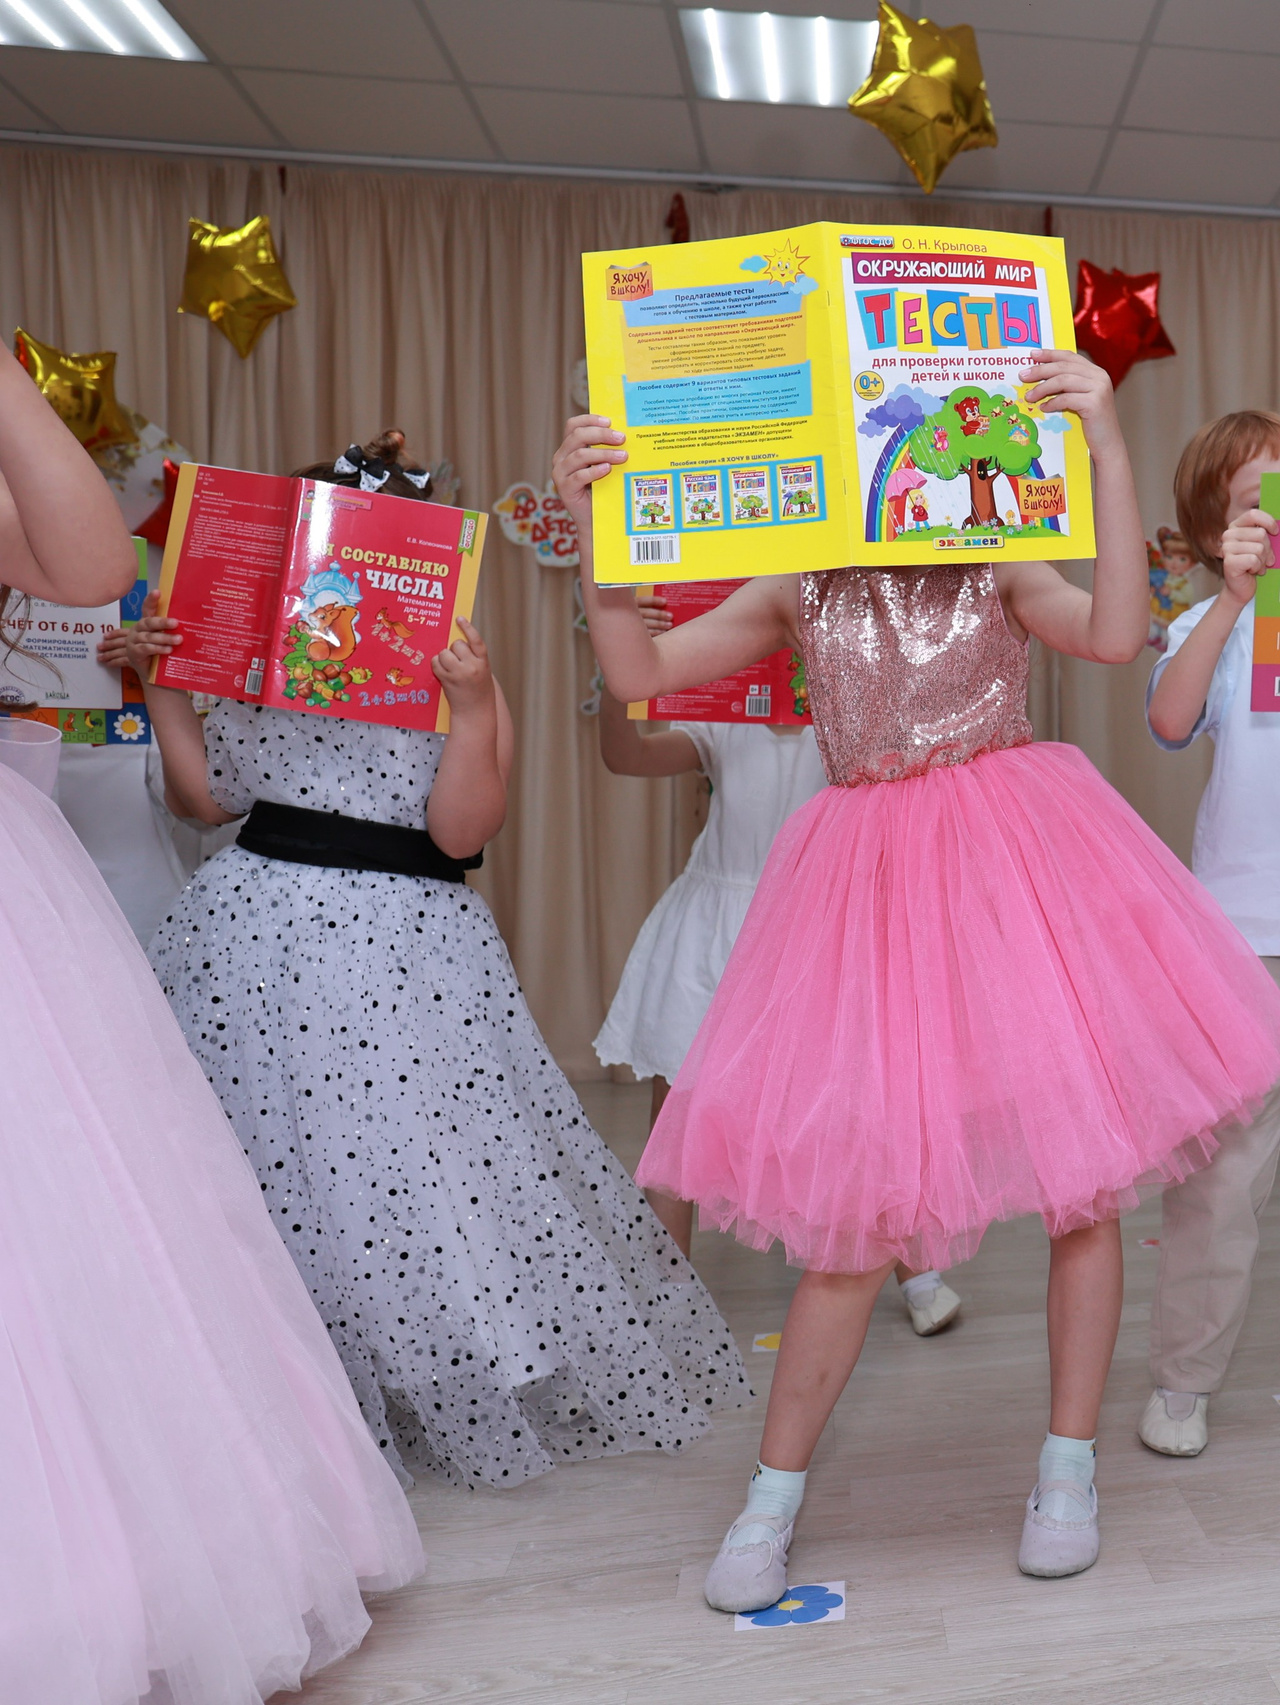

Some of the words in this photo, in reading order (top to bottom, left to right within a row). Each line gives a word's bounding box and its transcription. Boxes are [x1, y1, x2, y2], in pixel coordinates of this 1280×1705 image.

[902, 238, 914, 249] О.
[918, 238, 930, 250] Н.
[934, 239, 987, 254] Крылова
[995, 265, 1032, 282] МИР
[675, 289, 732, 302] Предлагаемые
[733, 287, 754, 296] тесты
[864, 293, 1040, 349] ТЕСТЫ
[872, 357, 896, 369] для
[900, 356, 964, 368] проверки
[859, 375, 880, 389] 0+
[912, 370, 949, 383] детей
[954, 372, 960, 381] к
[963, 371, 1005, 381] школе
[670, 459, 696, 467] Пособия
[698, 457, 716, 465] серии
[726, 454, 743, 462] ХОЧУ
[751, 451, 778, 460] ШКОЛУ»
[531, 515, 576, 542] ДЕТС
[418, 539, 453, 550] Колесникова
[553, 537, 578, 556] СА
[341, 546, 449, 577] СОСТАВЛЯЮ
[365, 569, 444, 600] ЧИСЛА
[397, 596, 442, 609] Математика
[403, 606, 417, 614] для
[418, 608, 440, 617] детей
[38, 621, 57, 631] ОТ
[61, 622, 68, 632] 6
[73, 622, 93, 634] ДО
[100, 624, 113, 633] 10
[407, 614, 425, 624] 5–7
[425, 619, 440, 627] лет
